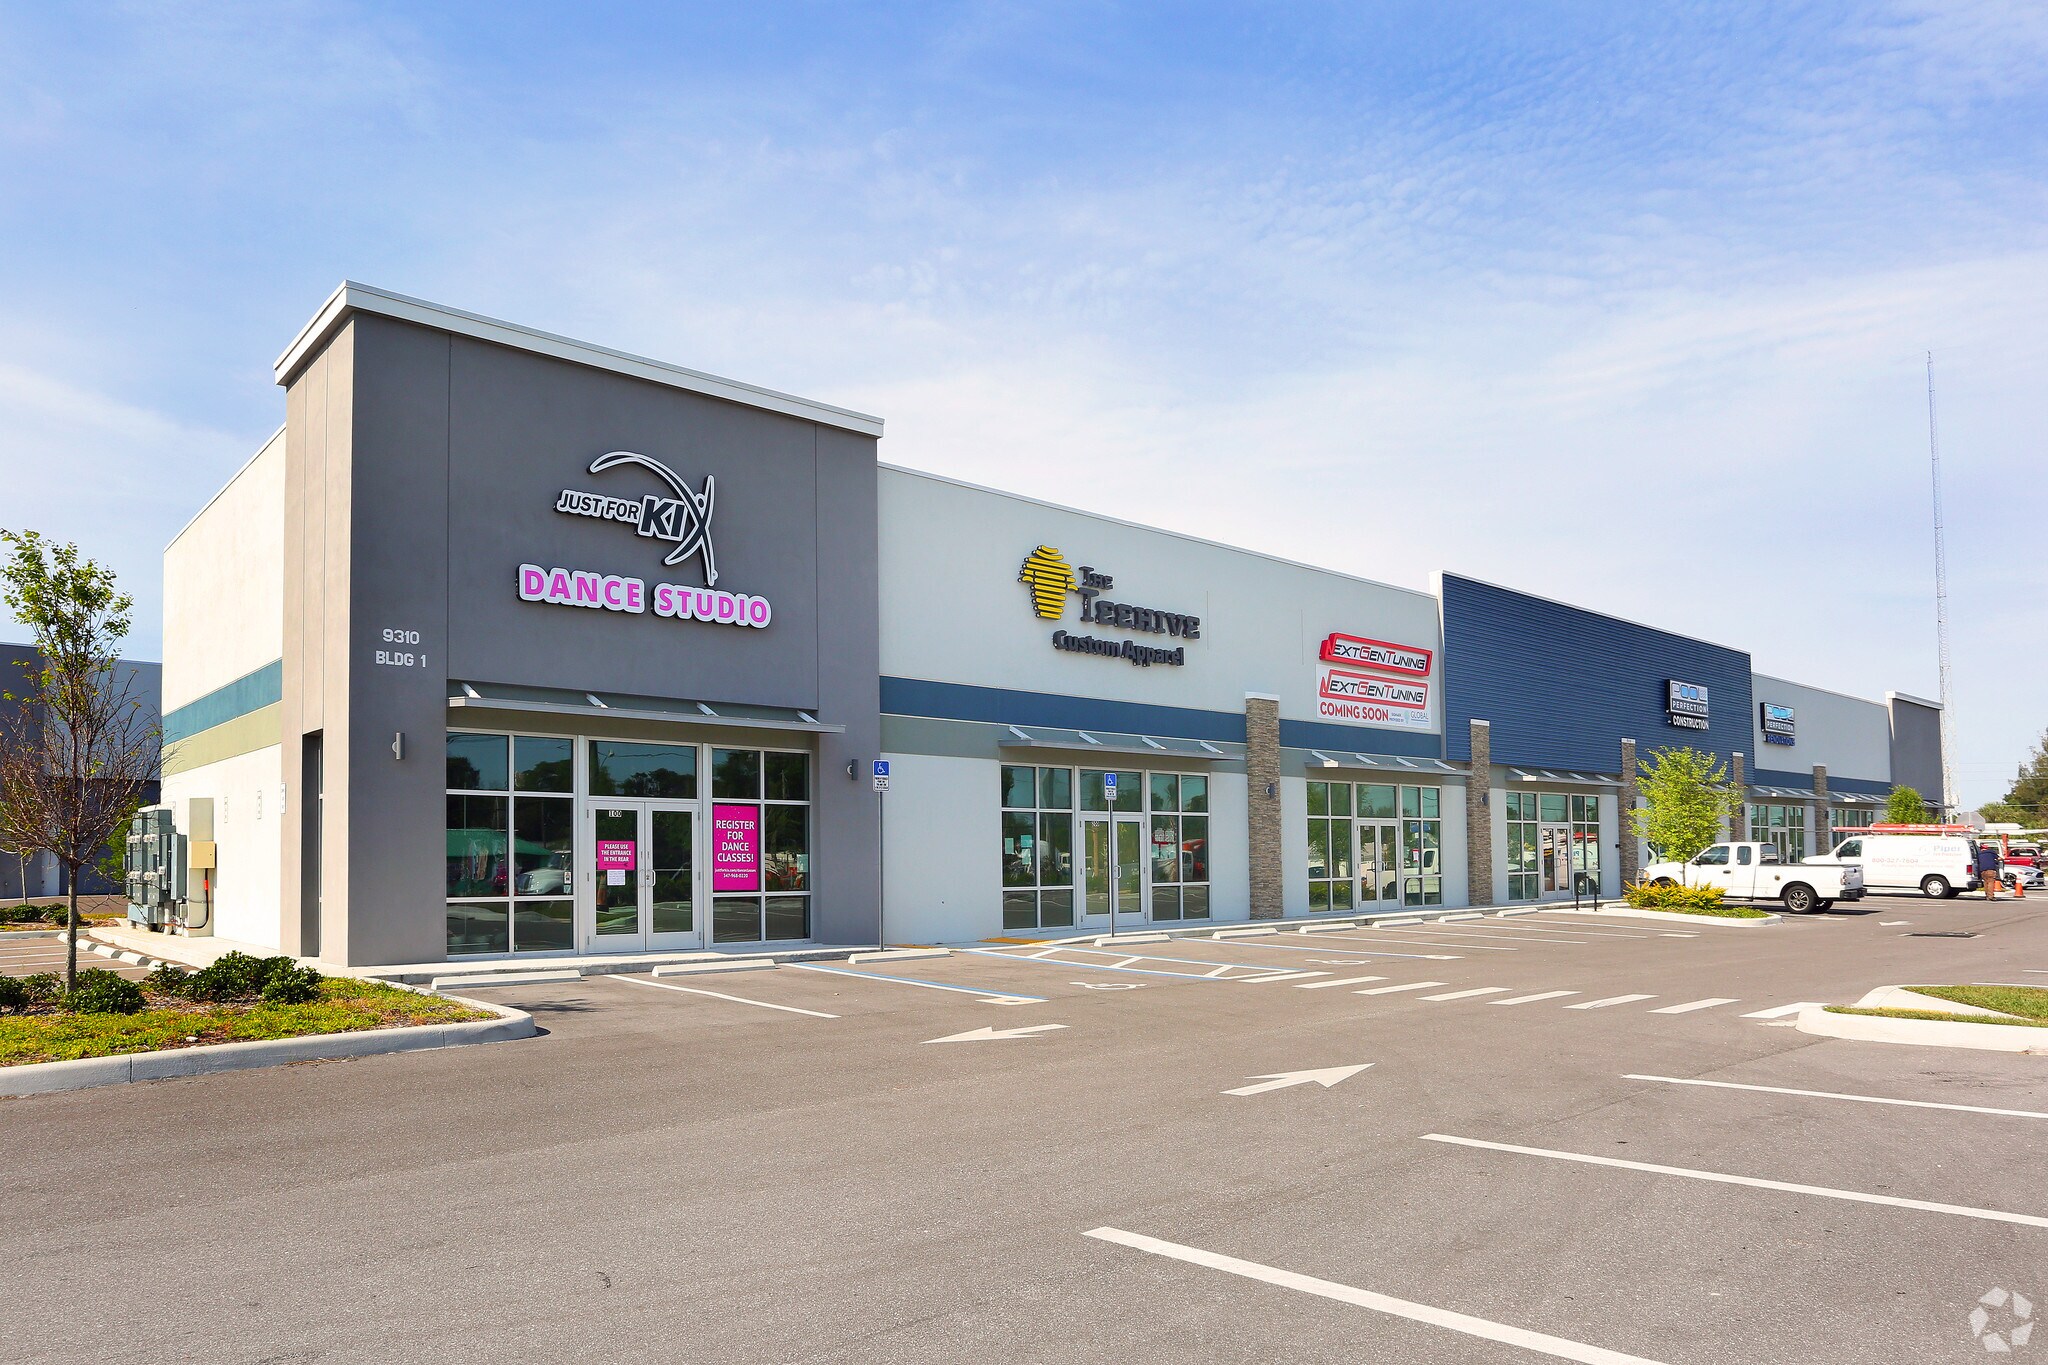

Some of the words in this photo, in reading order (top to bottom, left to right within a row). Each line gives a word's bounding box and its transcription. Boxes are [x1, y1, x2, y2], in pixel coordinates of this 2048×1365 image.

[557, 491, 602, 515] JUST
[604, 499, 640, 521] FOR
[1079, 566, 1114, 590] THE
[521, 567, 643, 611] DANCE
[656, 585, 769, 626] STUDIO
[1077, 587, 1200, 639] TEEHIVE
[382, 628, 420, 645] 9310
[1052, 629, 1120, 657] Custom
[1121, 640, 1185, 667] Apparel
[375, 650, 415, 667] BLDG
[420, 654, 427, 668] 1
[1320, 701, 1360, 718] COMING
[1362, 706, 1389, 721] SOON
[1410, 710, 1429, 720] GLOBAL
[1672, 700, 1707, 714] PERFECTION
[1672, 715, 1709, 731] CONSTRUCTION
[716, 819, 755, 830] REGISTER
[727, 831, 744, 840] FOR
[722, 842, 749, 851] DANCE
[1933, 845, 1961, 853] Piper
[717, 853, 754, 863] CLASSES!
